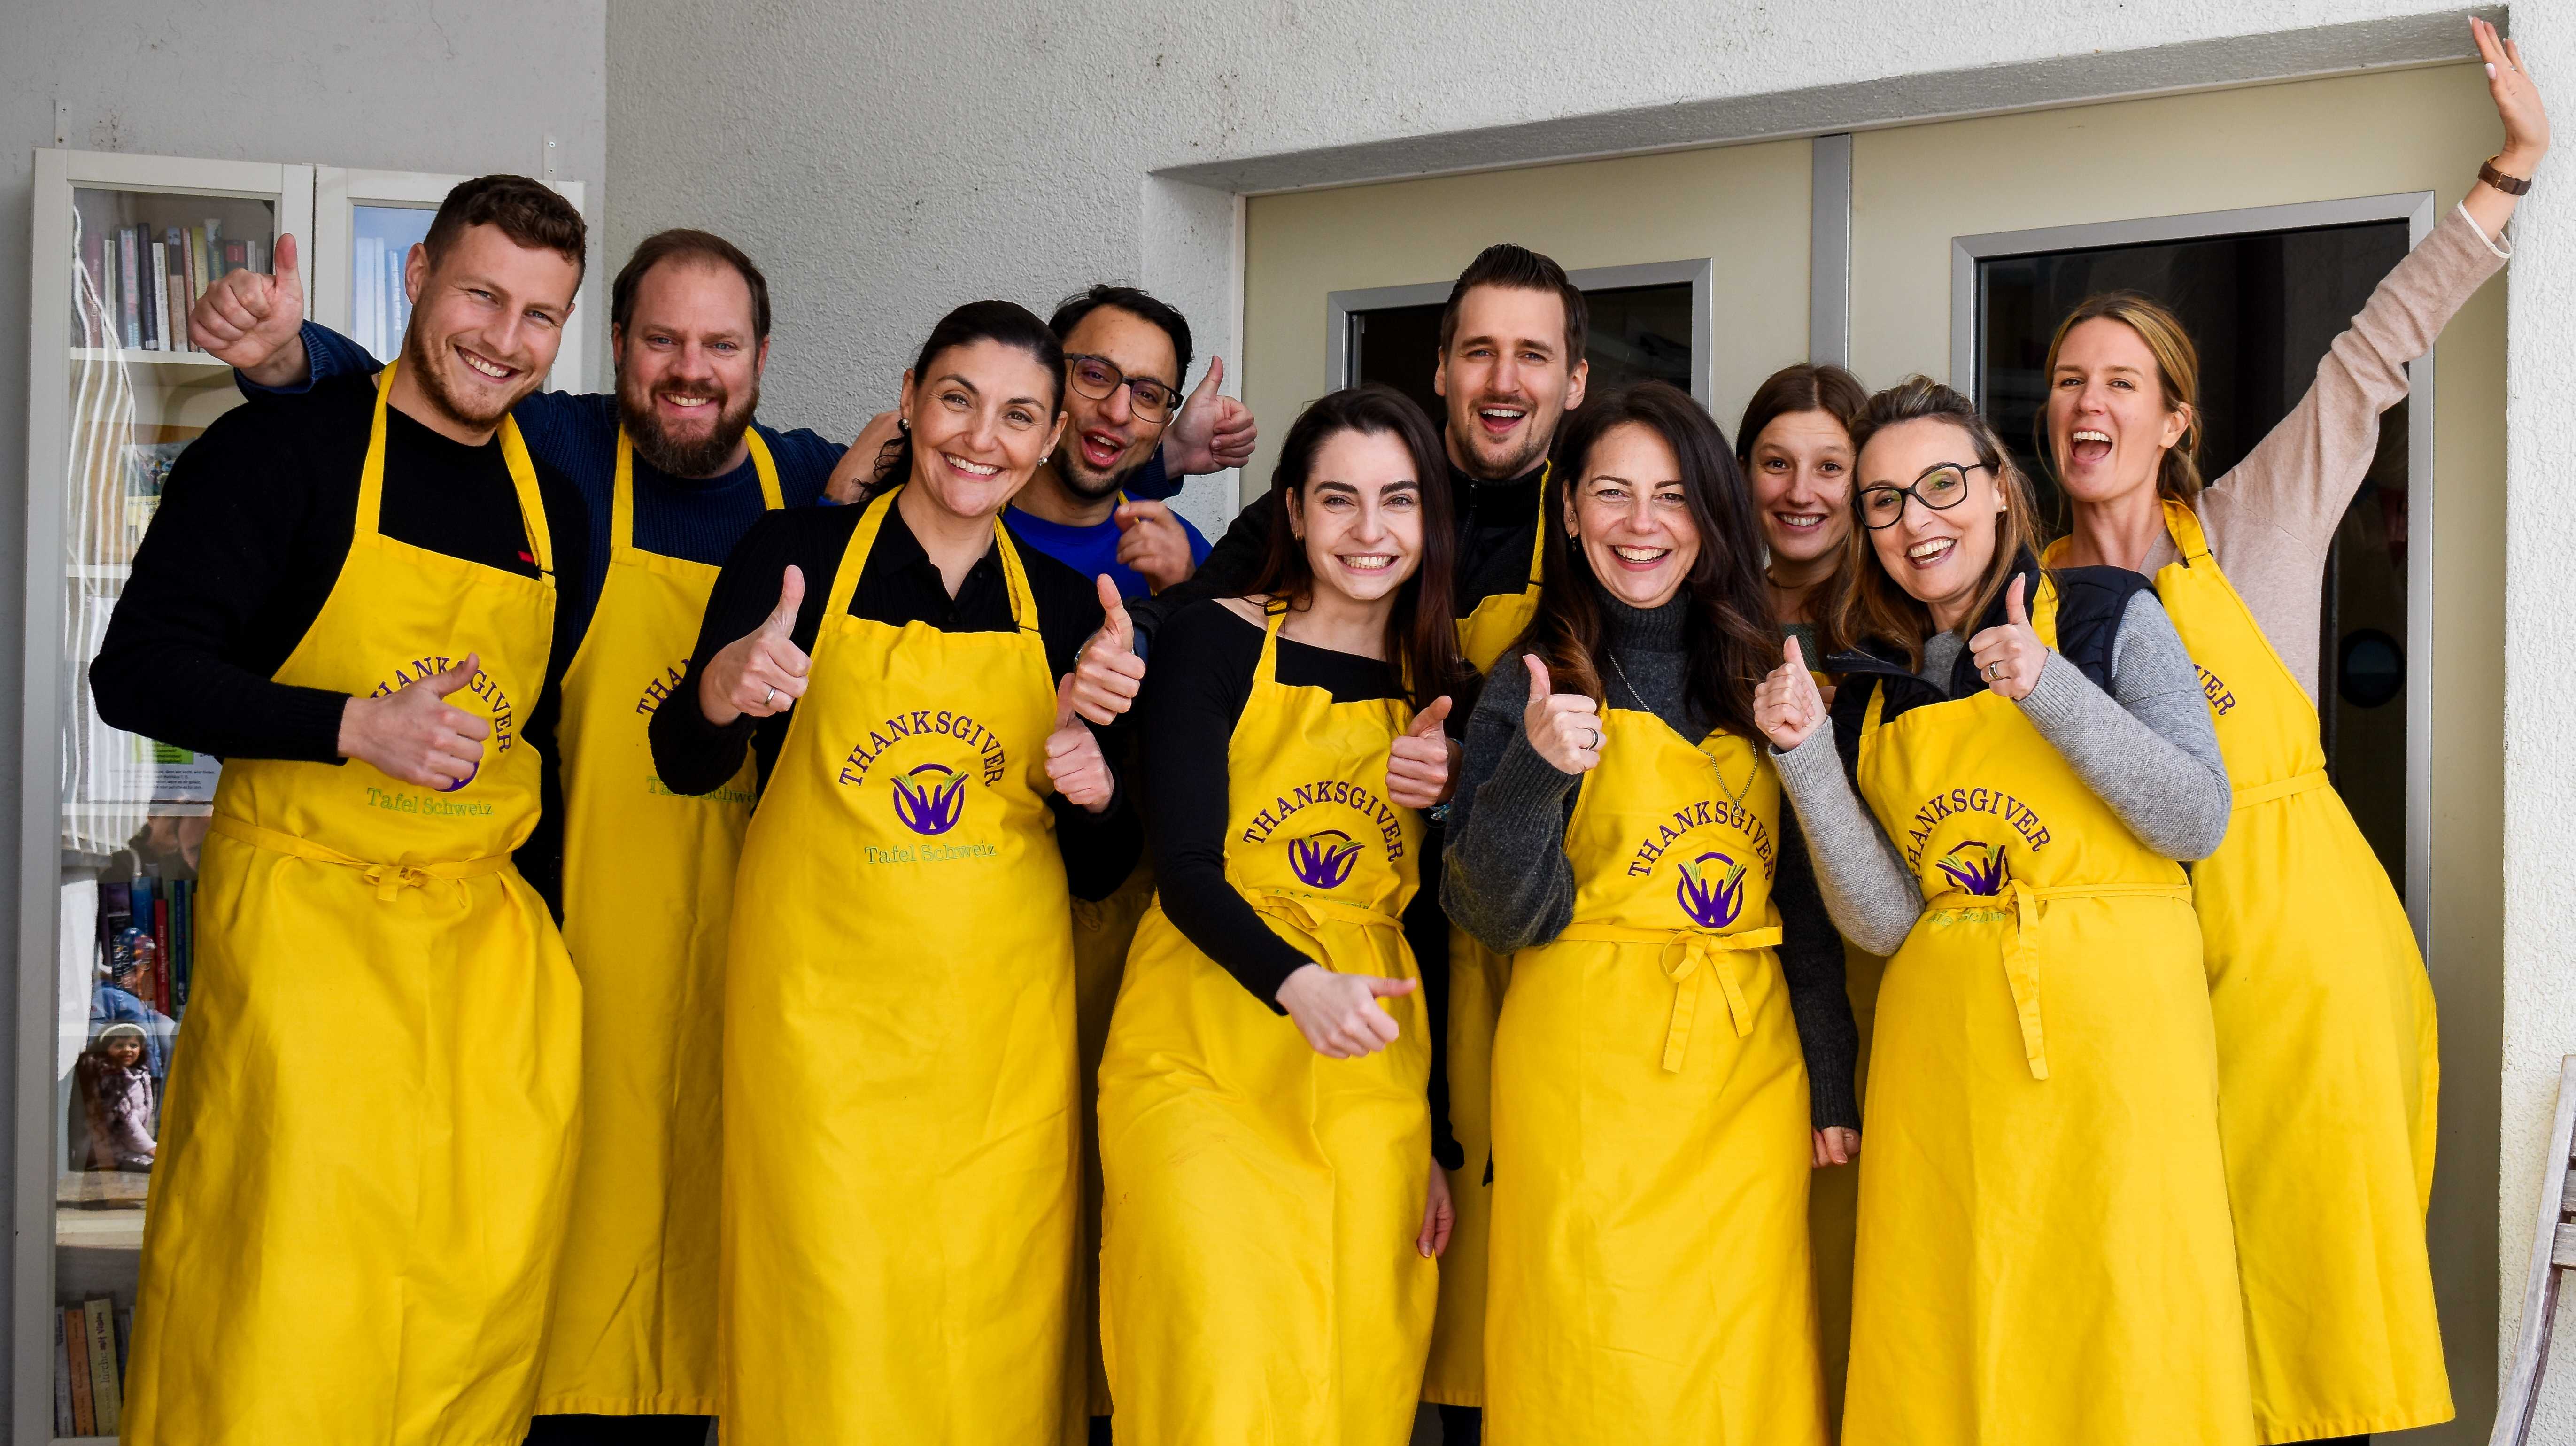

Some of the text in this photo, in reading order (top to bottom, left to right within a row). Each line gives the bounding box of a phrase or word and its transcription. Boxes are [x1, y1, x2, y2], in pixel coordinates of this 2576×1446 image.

[370, 656, 512, 753] ANKGIVER
[838, 710, 1006, 787] THANKSGIVER
[367, 788, 494, 816] Tafel Schweiz
[1243, 780, 1404, 863] THANKSGIVER
[1627, 800, 1774, 881] THANKSGIVER
[864, 840, 997, 864] Tafel Schweiz
